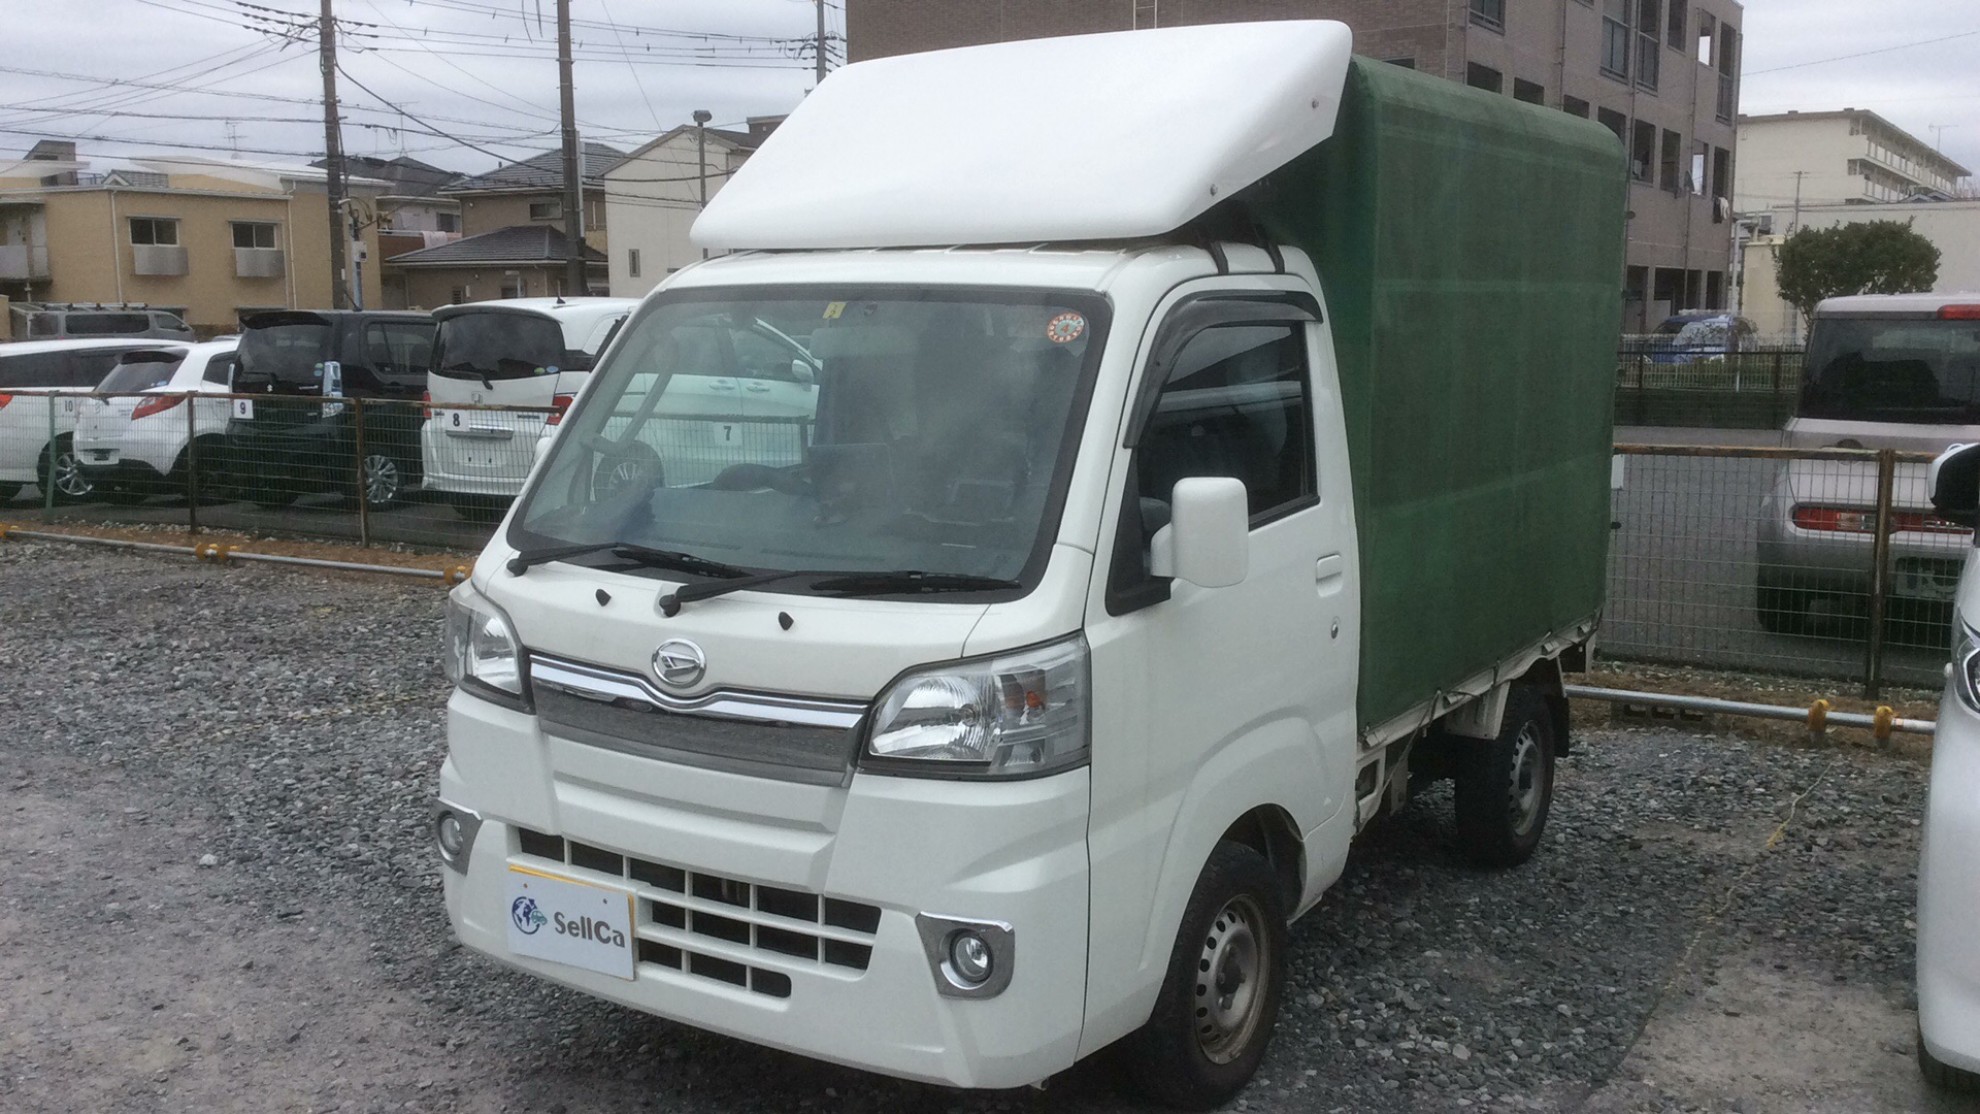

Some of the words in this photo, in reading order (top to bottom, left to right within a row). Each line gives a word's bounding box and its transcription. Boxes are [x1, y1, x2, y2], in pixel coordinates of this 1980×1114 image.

[65, 400, 73, 413] 10
[240, 401, 246, 415] 9
[453, 412, 460, 427] 8
[723, 425, 731, 441] 7
[554, 911, 625, 948] SellCa
